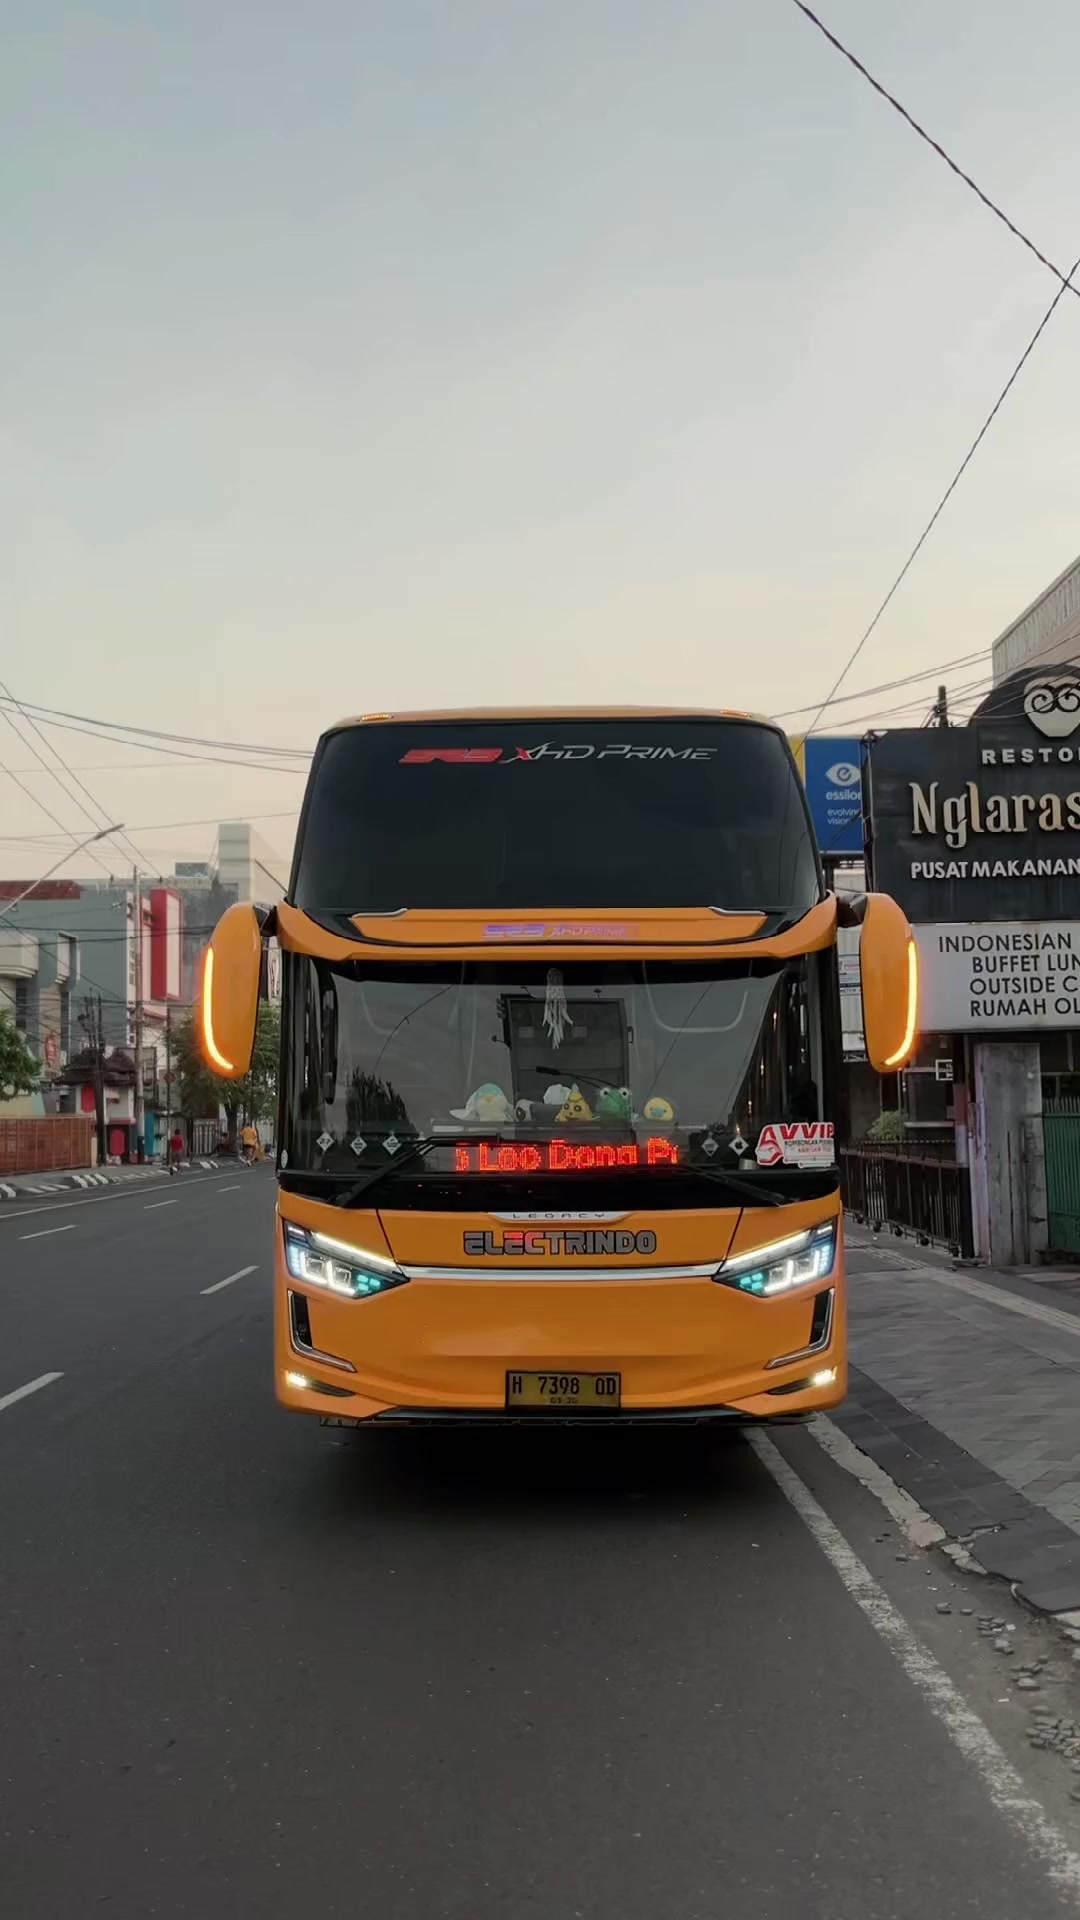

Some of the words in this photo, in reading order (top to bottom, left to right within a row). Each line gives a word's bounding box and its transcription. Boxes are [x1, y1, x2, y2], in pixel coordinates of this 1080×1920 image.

[597, 744, 719, 760] PRIME
[981, 746, 1080, 765] RESTO
[911, 861, 968, 879] PUSAT
[971, 858, 1080, 878] MAKANAN
[938, 932, 1072, 953] INDONESIAN
[972, 954, 1040, 974] BUFFET
[969, 976, 1055, 995] OUTSIDE
[970, 998, 1046, 1017] RUMAH
[463, 1230, 657, 1256] ELECTRINDO
[512, 1375, 522, 1395] H
[537, 1376, 580, 1395] 7398
